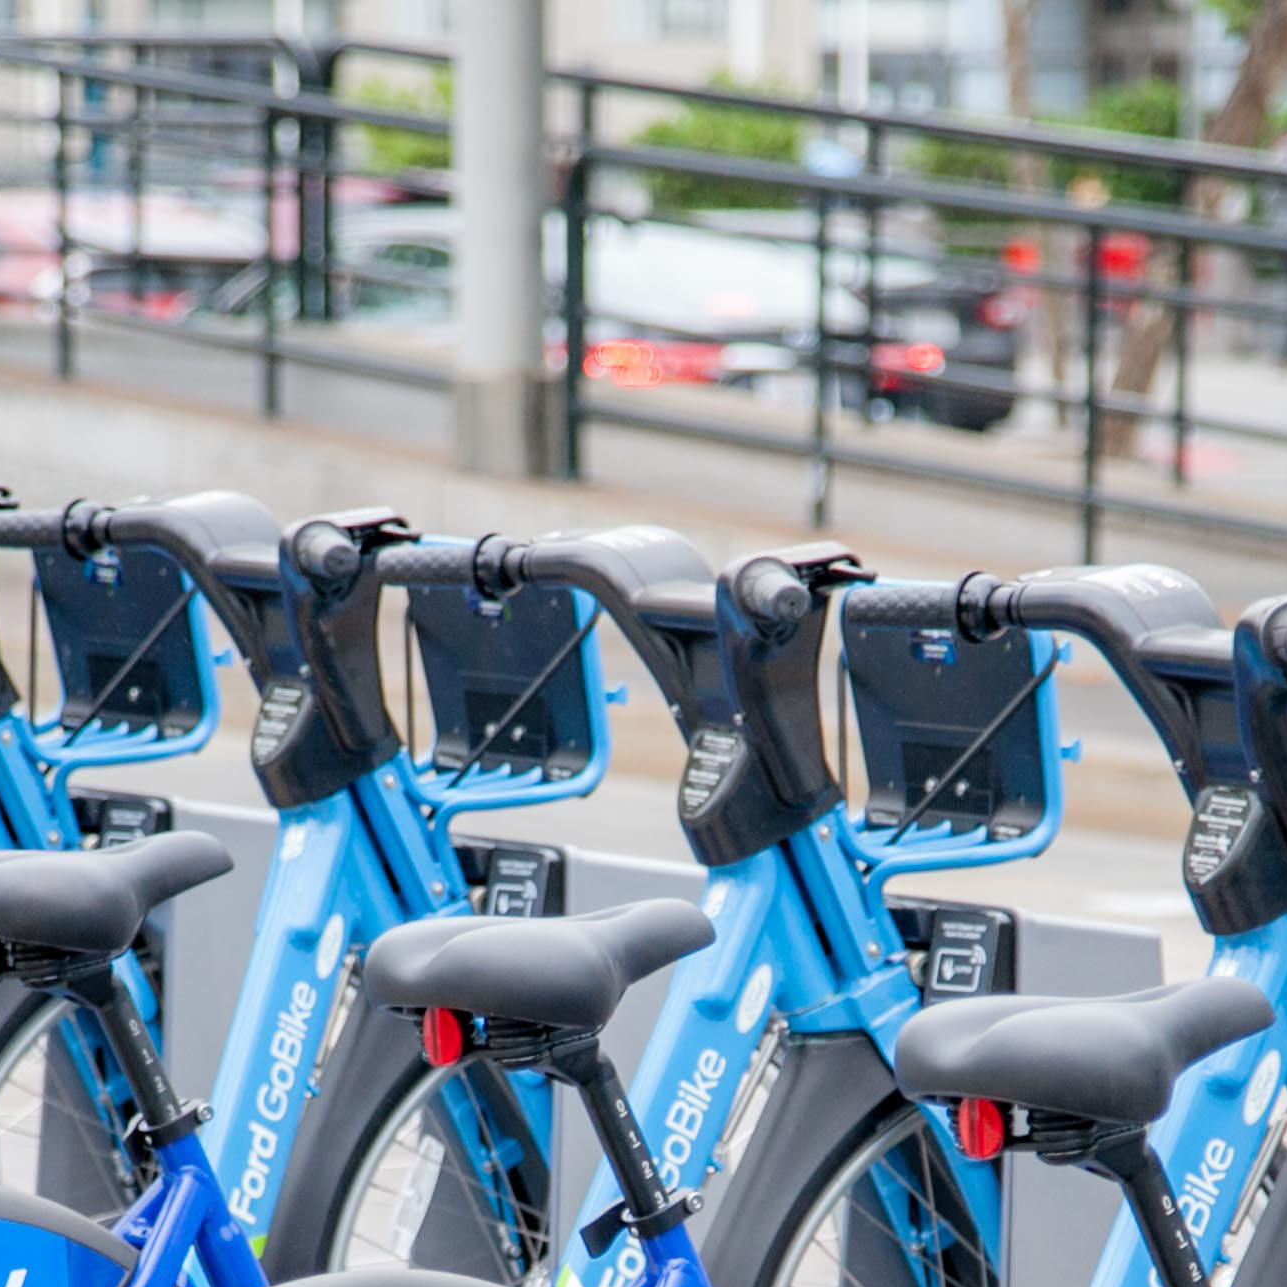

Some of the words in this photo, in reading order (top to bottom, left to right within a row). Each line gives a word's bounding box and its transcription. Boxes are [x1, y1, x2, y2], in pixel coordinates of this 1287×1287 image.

[227, 1121, 278, 1226] Ford
[256, 980, 317, 1123] GoBike
[1162, 1195, 1174, 1213] 0
[1175, 1229, 1187, 1248] 1
[1188, 1262, 1201, 1281] 2
